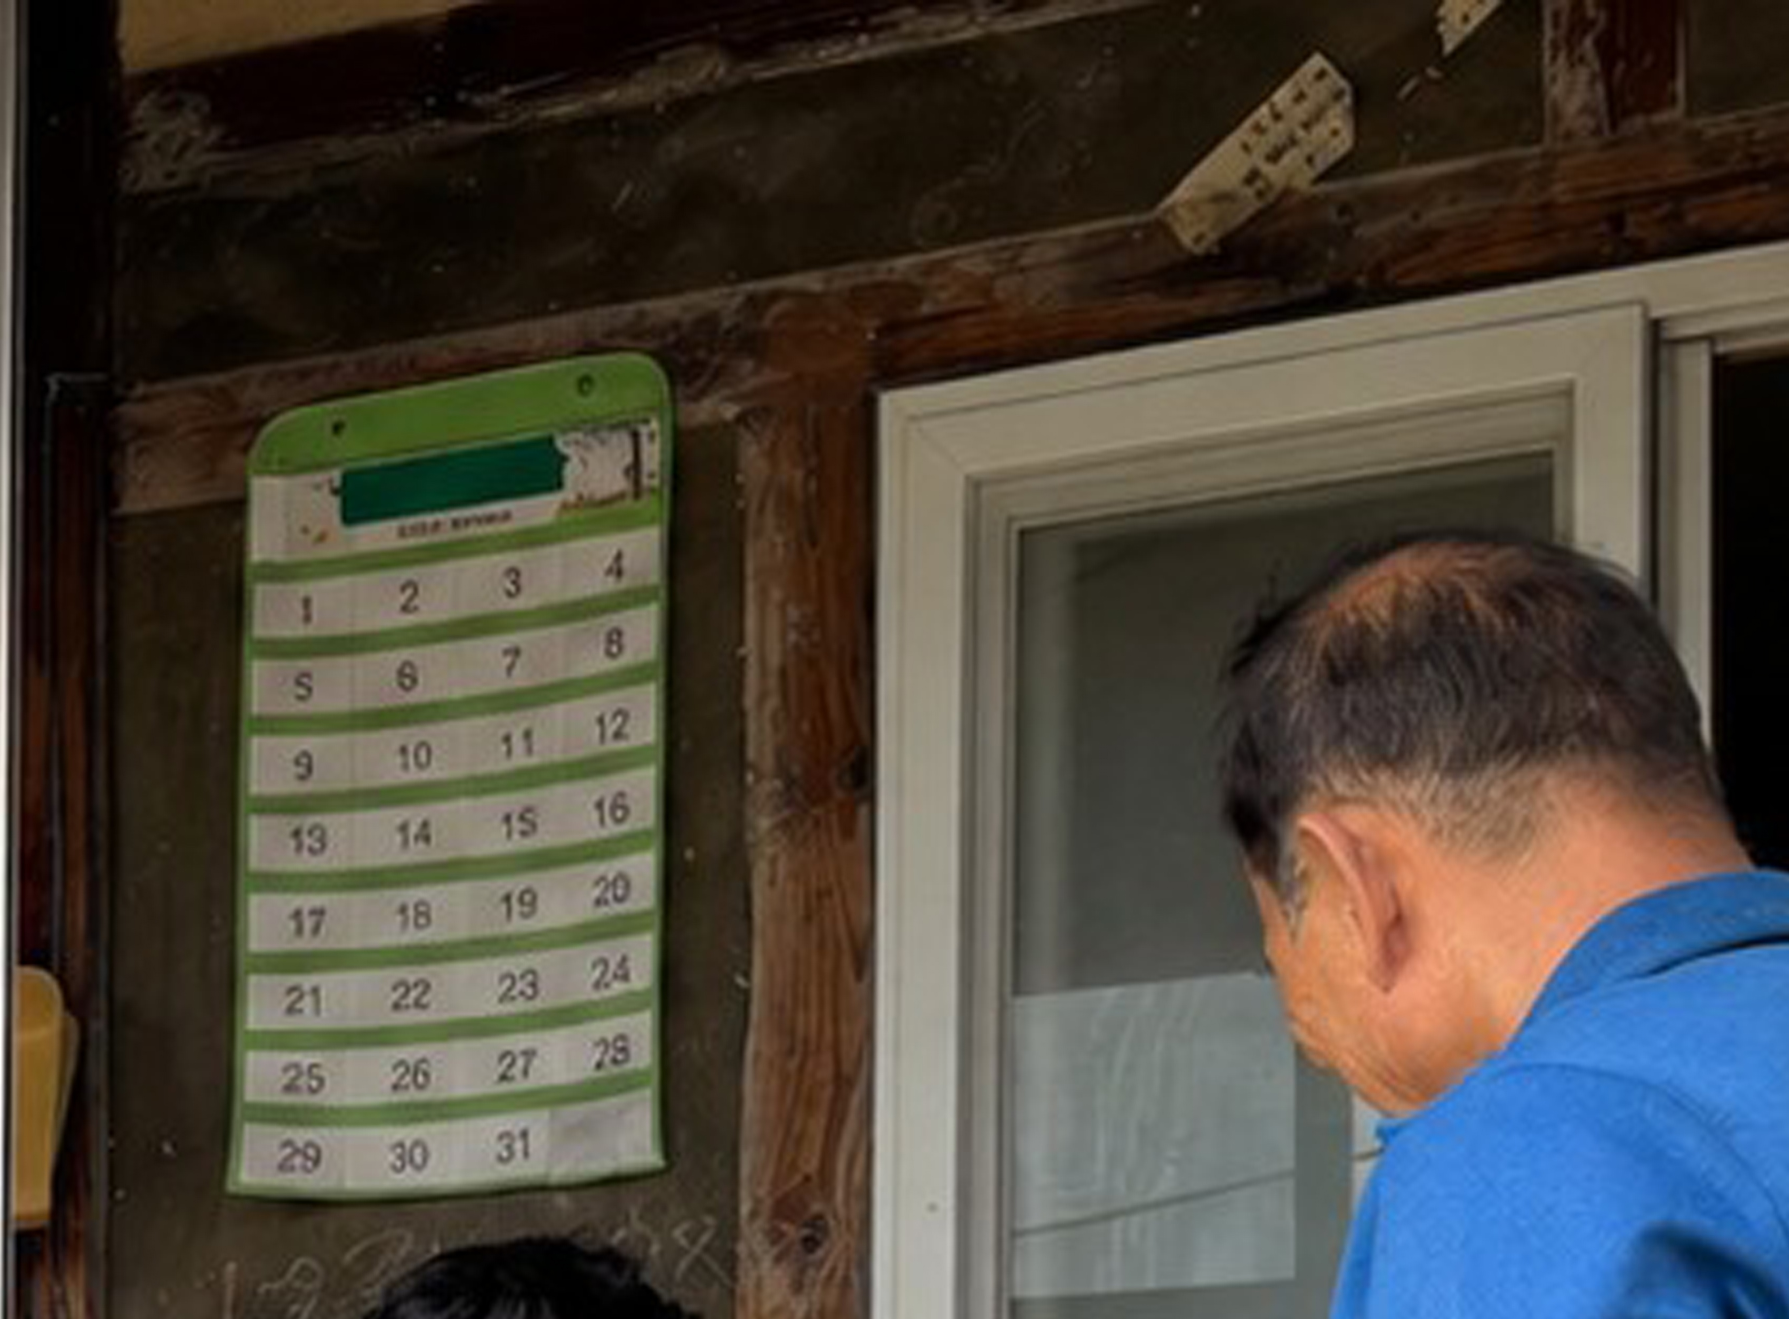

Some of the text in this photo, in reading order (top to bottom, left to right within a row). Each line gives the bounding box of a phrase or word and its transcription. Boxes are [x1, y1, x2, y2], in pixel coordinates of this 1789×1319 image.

[300, 548, 626, 626] 1 2 3 4
[292, 625, 626, 703] 5 6 7 8
[292, 706, 631, 781] 9 10 11 12
[289, 789, 632, 857] 13 14 15 16
[288, 870, 633, 939] 17 18 19 20
[283, 952, 632, 1017] 21 22 23 24
[280, 1032, 632, 1097] 25 26 27 28
[276, 1127, 531, 1175] 29 30 31
